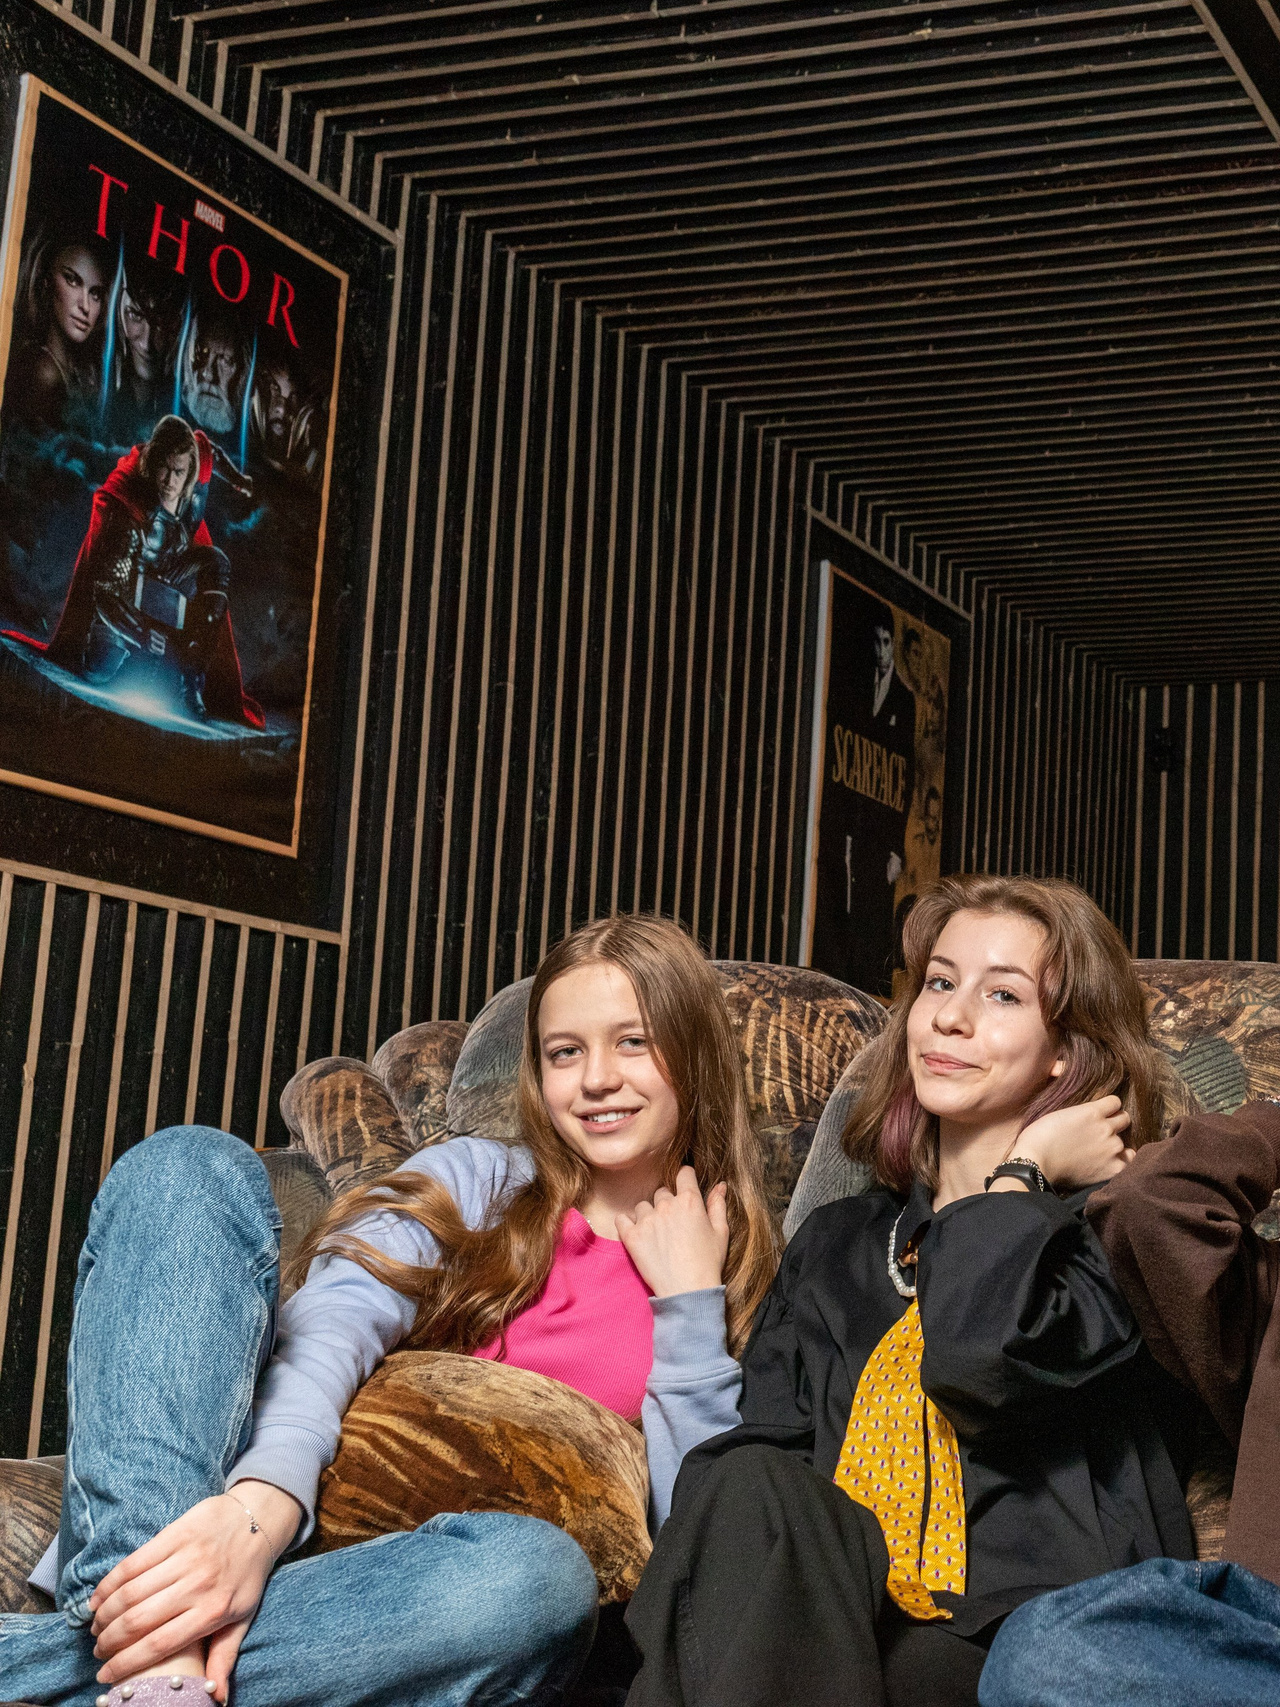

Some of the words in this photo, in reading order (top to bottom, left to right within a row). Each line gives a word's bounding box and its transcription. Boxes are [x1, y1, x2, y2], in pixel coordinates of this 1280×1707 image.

[89, 163, 299, 348] THOR
[195, 200, 224, 231] MARVEL
[832, 724, 906, 812] SCARFACE
